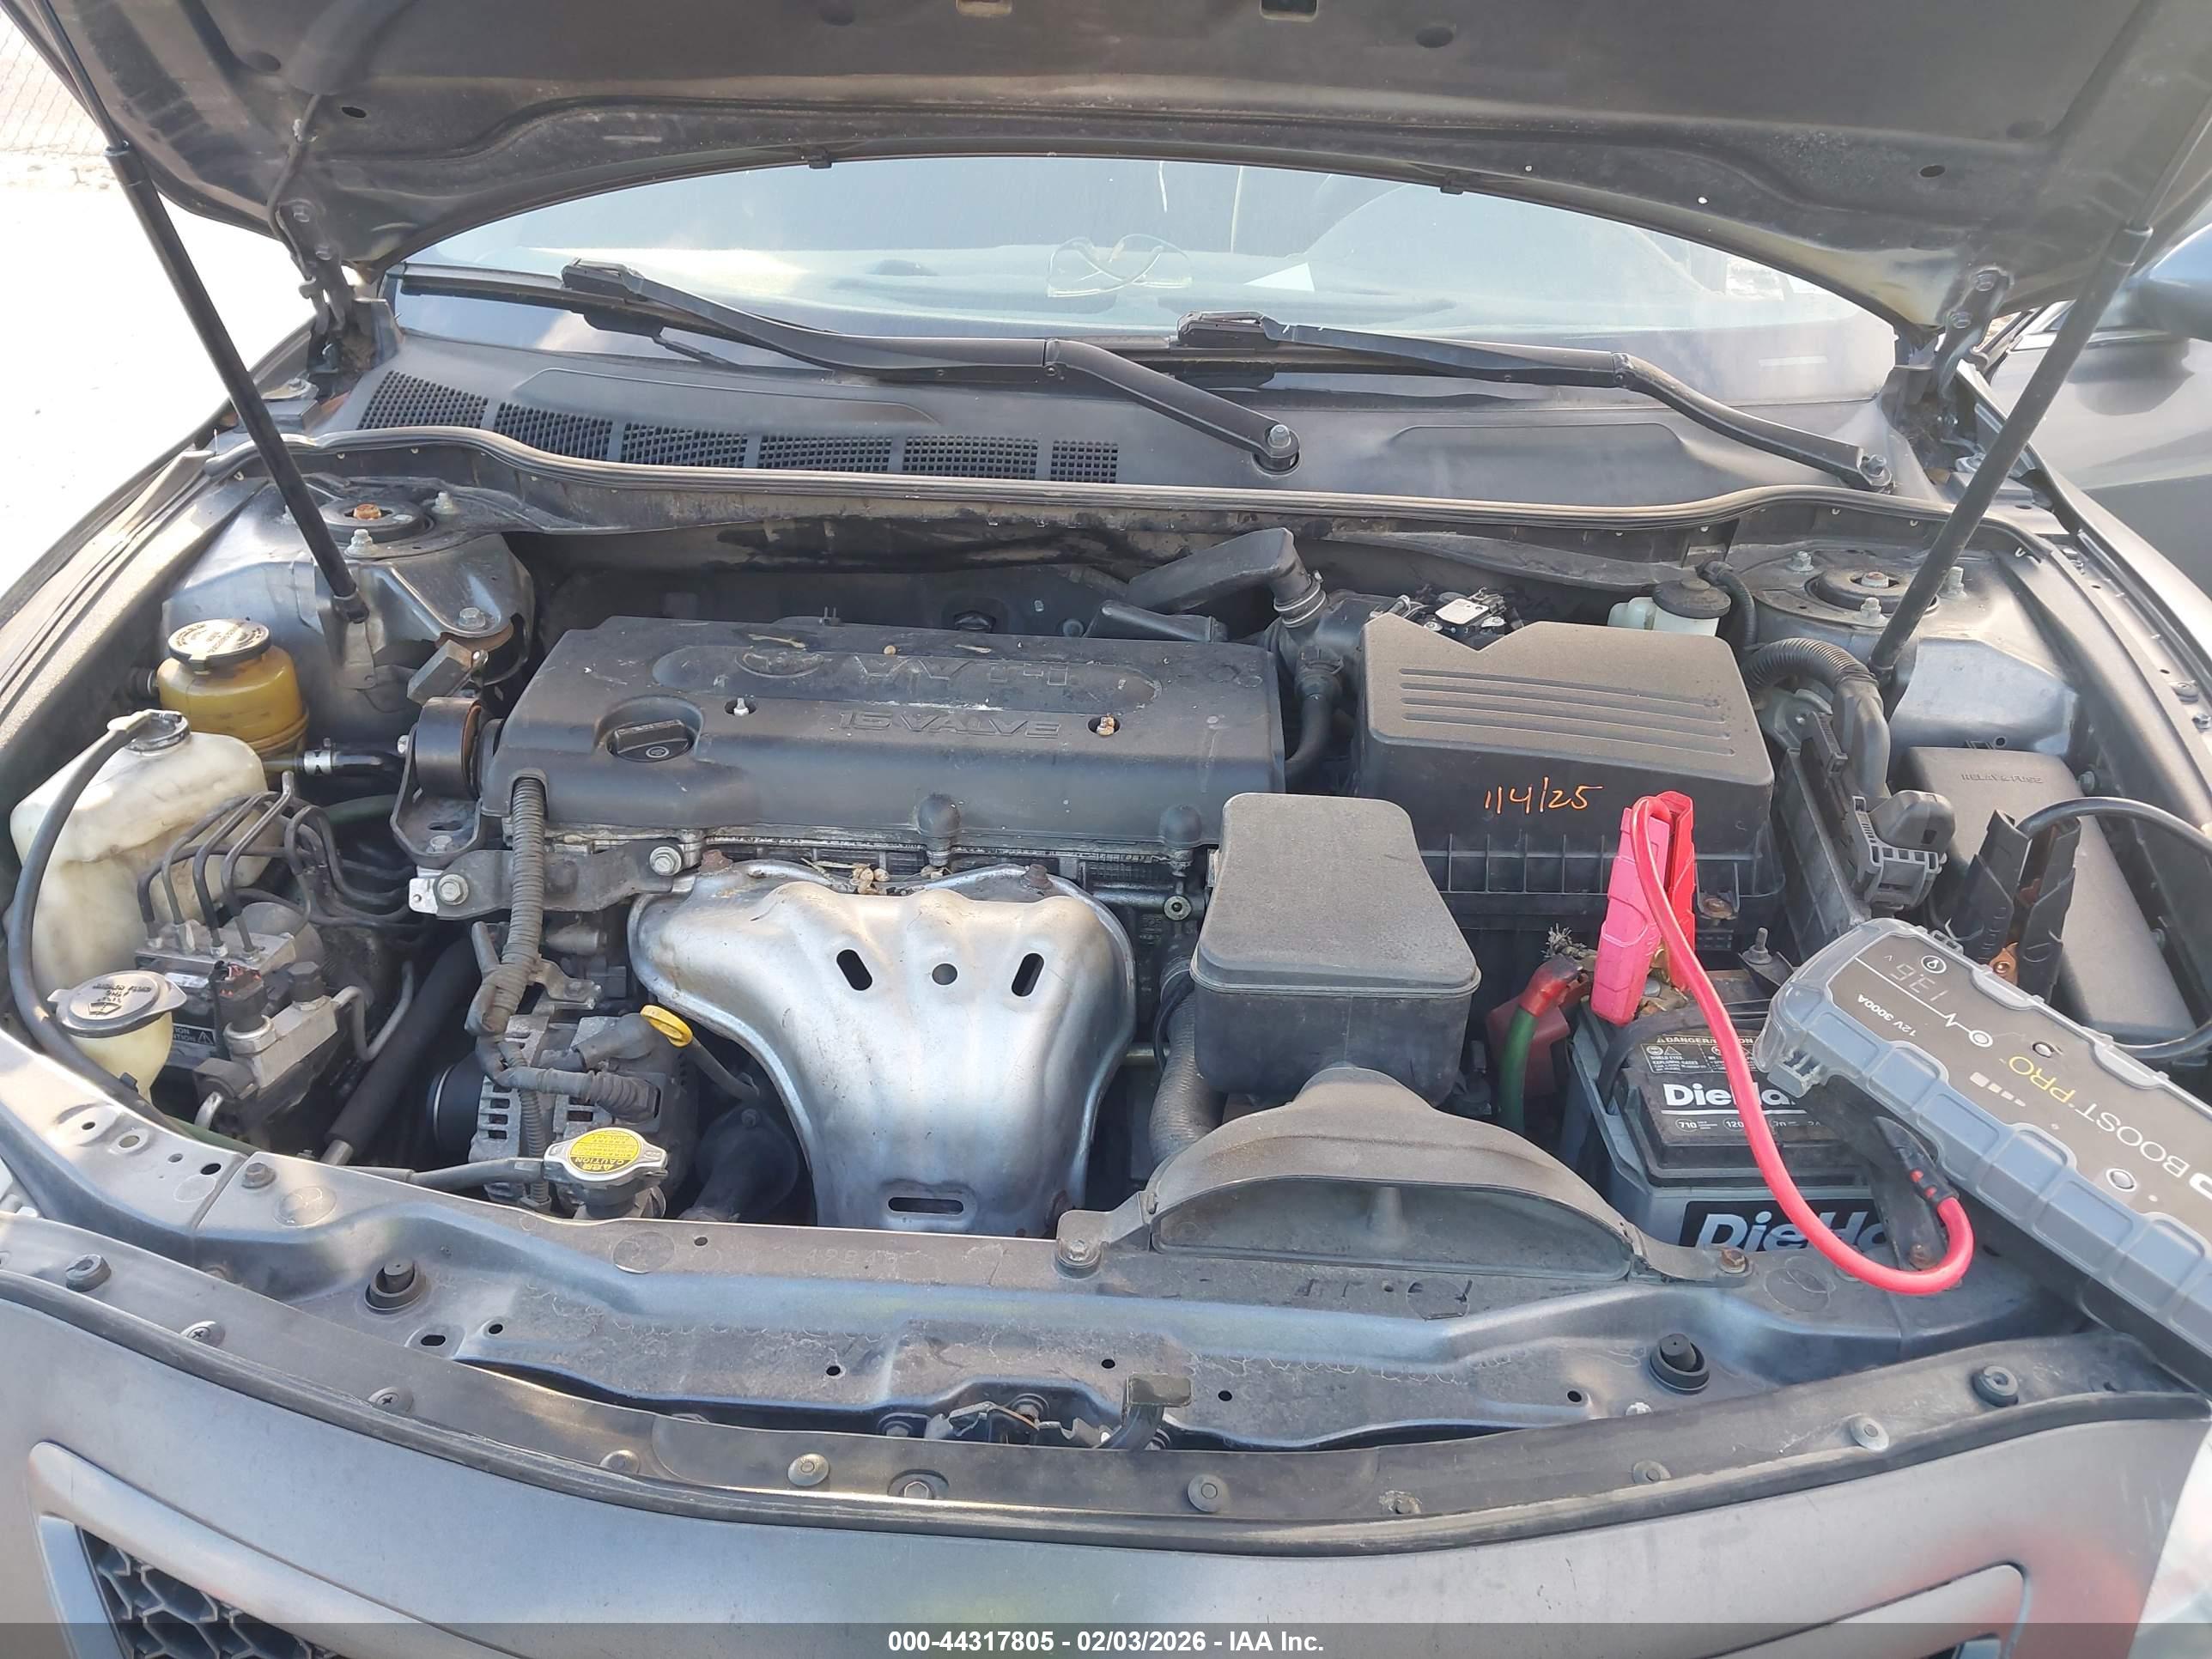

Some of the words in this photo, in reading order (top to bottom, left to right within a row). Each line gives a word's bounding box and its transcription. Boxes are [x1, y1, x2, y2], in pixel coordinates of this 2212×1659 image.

[900, 714, 1060, 739] VALVE
[1857, 994, 1894, 1022] 3000A
[1893, 1020, 1917, 1037] 12V
[2009, 1056, 2076, 1103] PRO
[2075, 1103, 2191, 1178] BOOST
[574, 1157, 625, 1165] CAUTION
